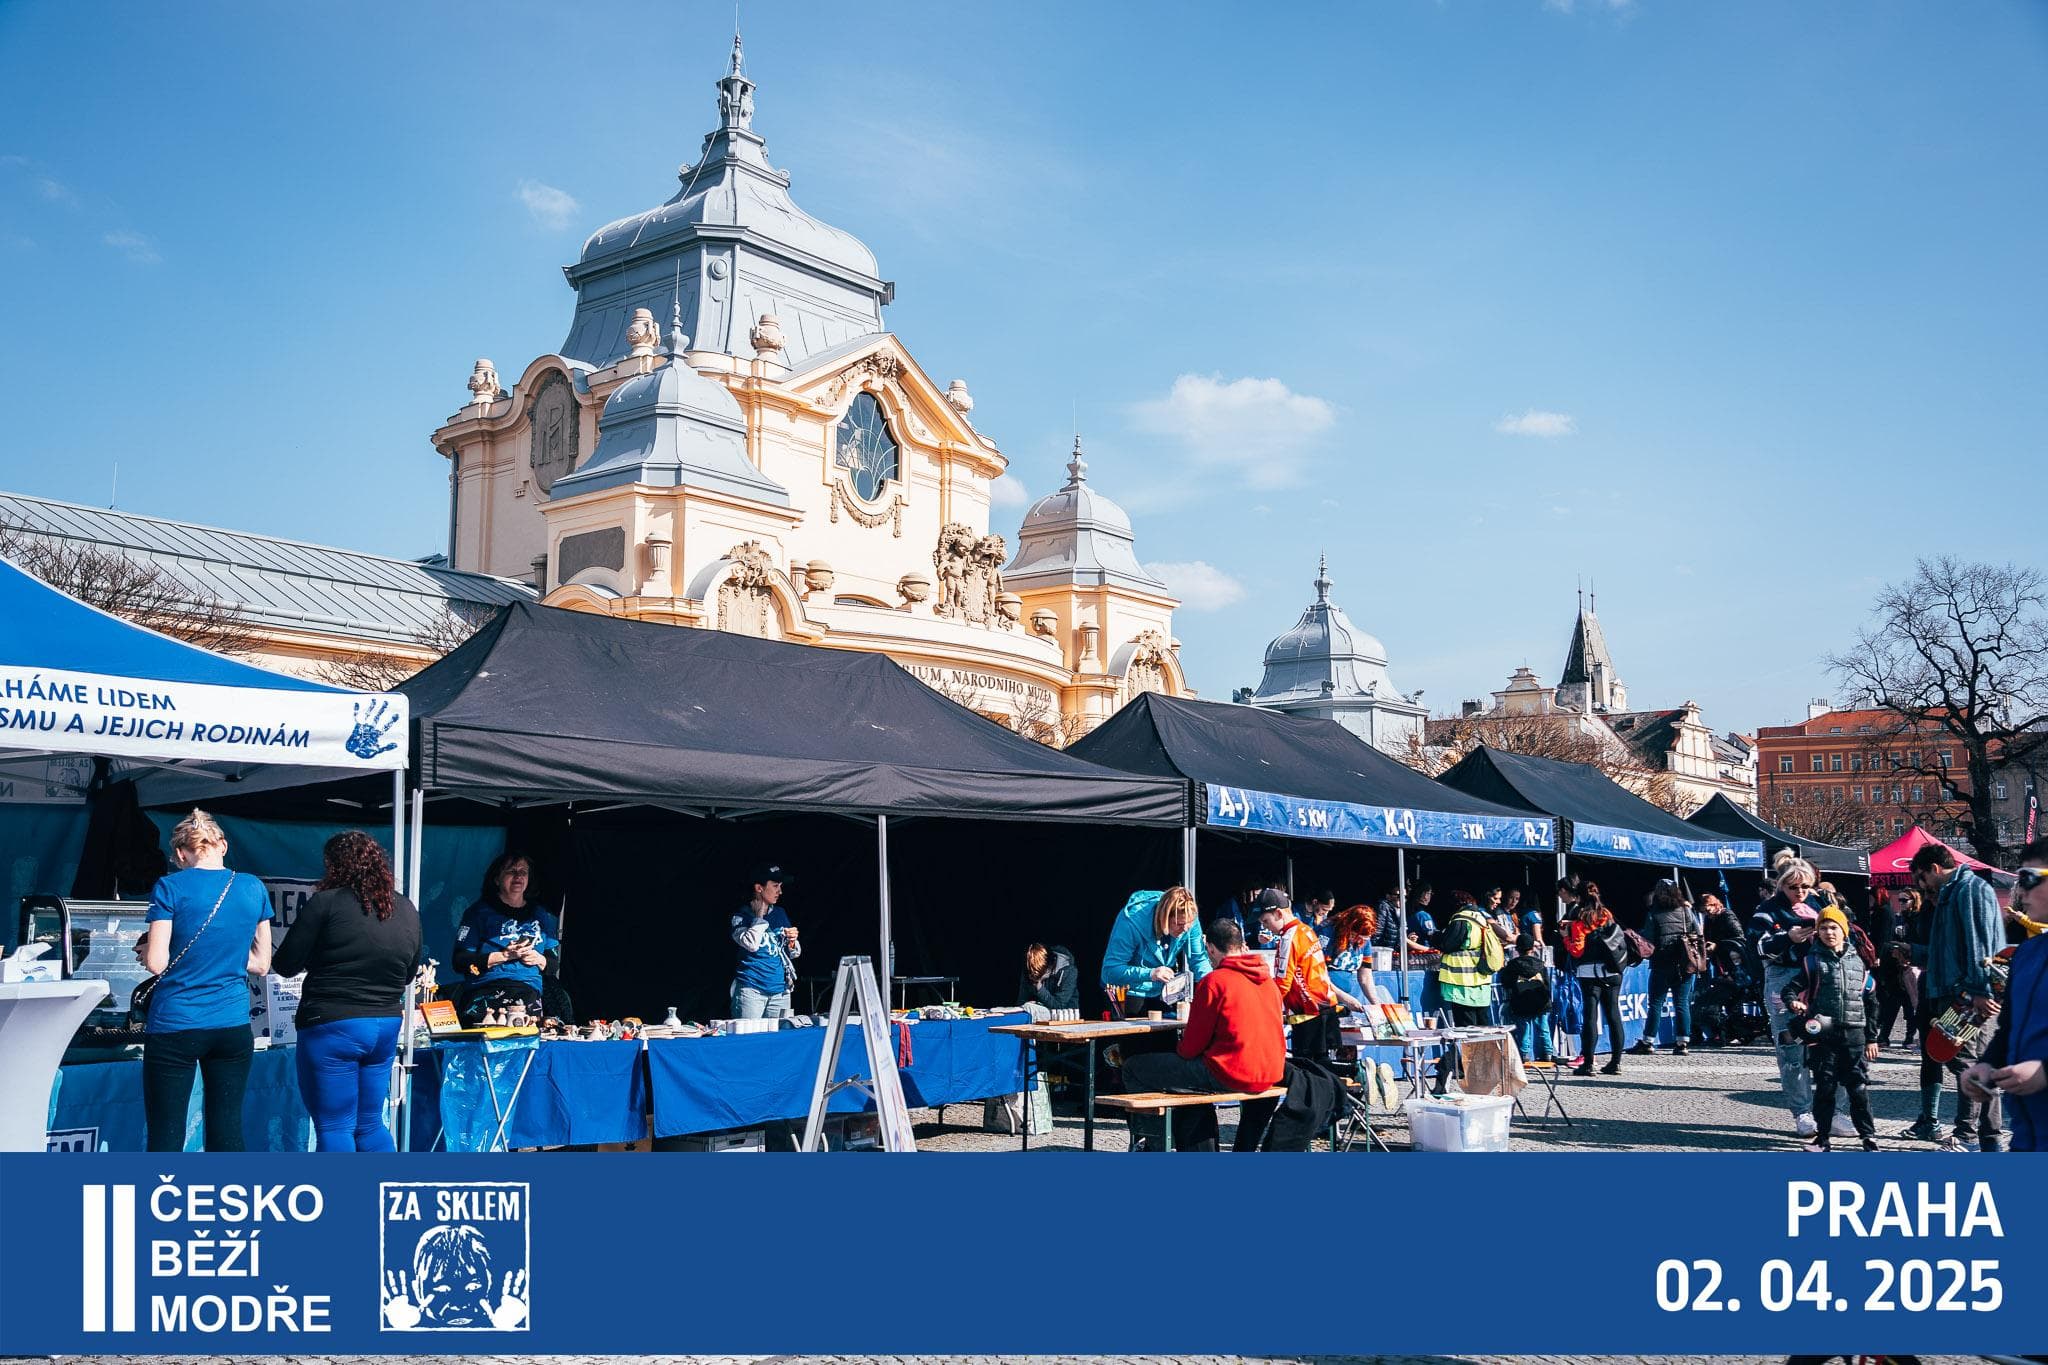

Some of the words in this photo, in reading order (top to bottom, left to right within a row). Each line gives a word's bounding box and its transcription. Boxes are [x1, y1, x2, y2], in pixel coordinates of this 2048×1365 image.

[902, 665, 941, 682] IUM
[951, 670, 1024, 695] NÁRODNÍHO
[97, 686, 177, 711] LIDEM
[63, 713, 84, 734] A
[94, 715, 184, 740] JEJICH
[190, 722, 310, 748] RODINÁM
[1219, 785, 1250, 827] A-J
[1298, 807, 1307, 826] 5
[1308, 808, 1329, 830] KM
[1461, 823, 1469, 839] 5
[1469, 823, 1486, 840] KM
[1523, 821, 1549, 847] R-Z
[1617, 993, 1650, 1022] ESK
